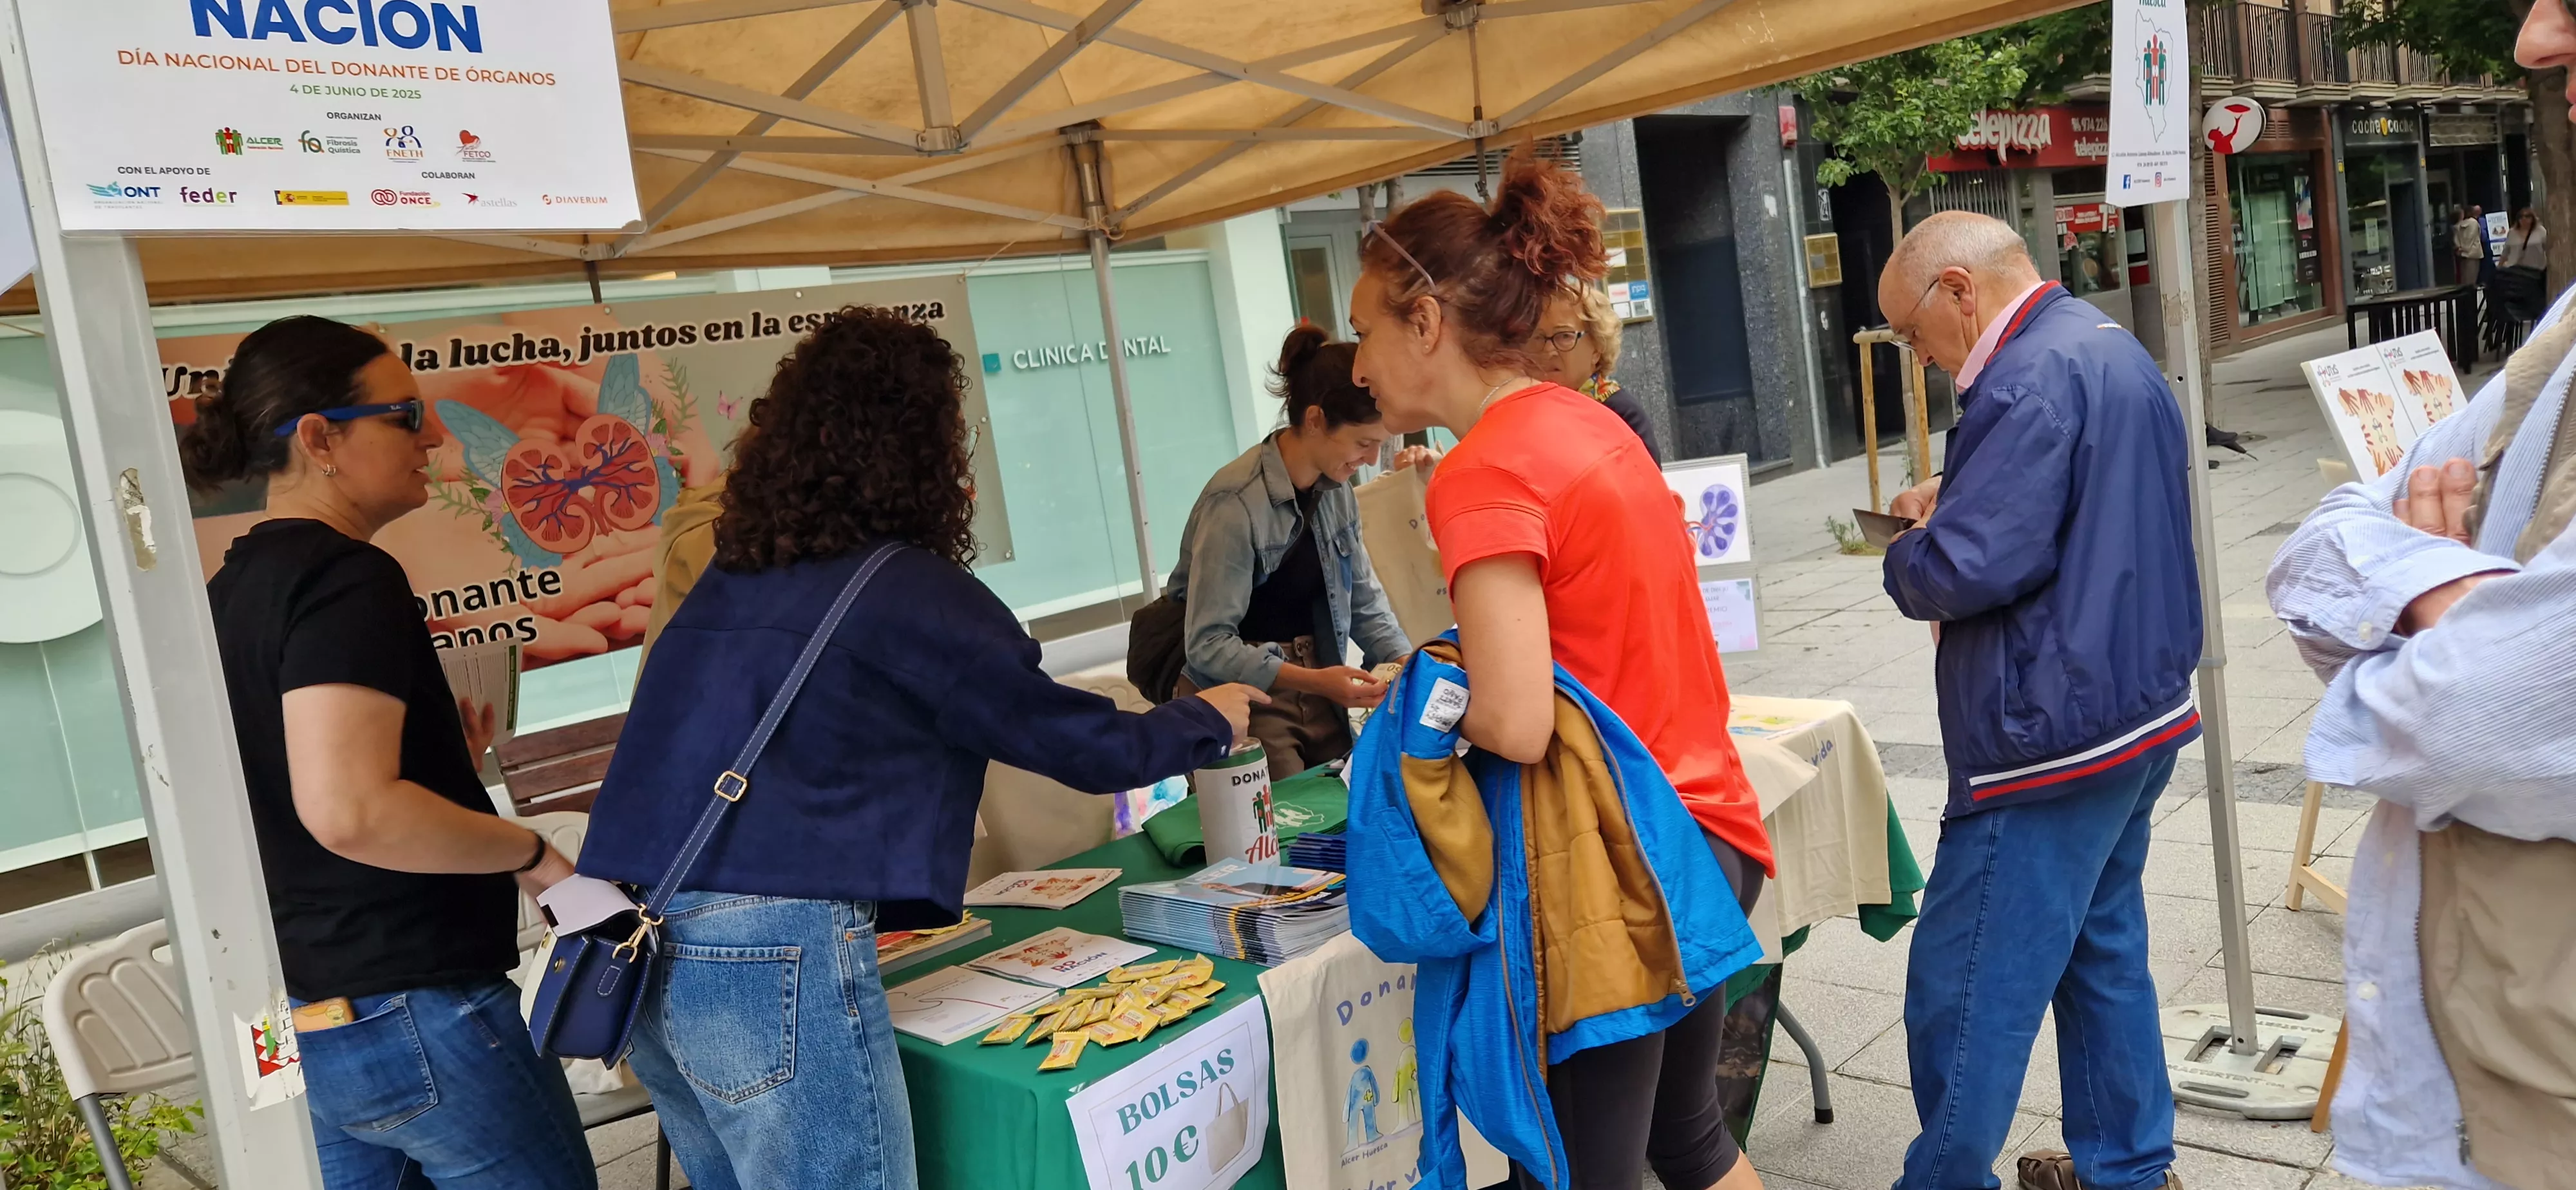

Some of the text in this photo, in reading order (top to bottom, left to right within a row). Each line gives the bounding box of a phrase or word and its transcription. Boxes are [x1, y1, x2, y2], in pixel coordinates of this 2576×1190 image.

[118, 48, 556, 86] DÍA NACIONAL DEL DONANTE DE ÓRGANOS
[290, 84, 421, 99] 4 DE JUNIO DE 2025
[327, 111, 382, 120] ORGANIZAN
[247, 137, 283, 146] ALCER
[124, 187, 161, 198] ONT
[180, 186, 237, 203] feder
[481, 198, 517, 207] astellas
[401, 343, 440, 372] la
[448, 333, 571, 362] lucha,
[580, 323, 697, 361] juntos
[705, 321, 744, 343] en
[752, 312, 782, 337] la
[1013, 335, 1171, 370] CLINICA DNTAL
[1116, 1048, 1235, 1135] BOLSAS
[1341, 1142, 1388, 1169] Alcer Huesca
